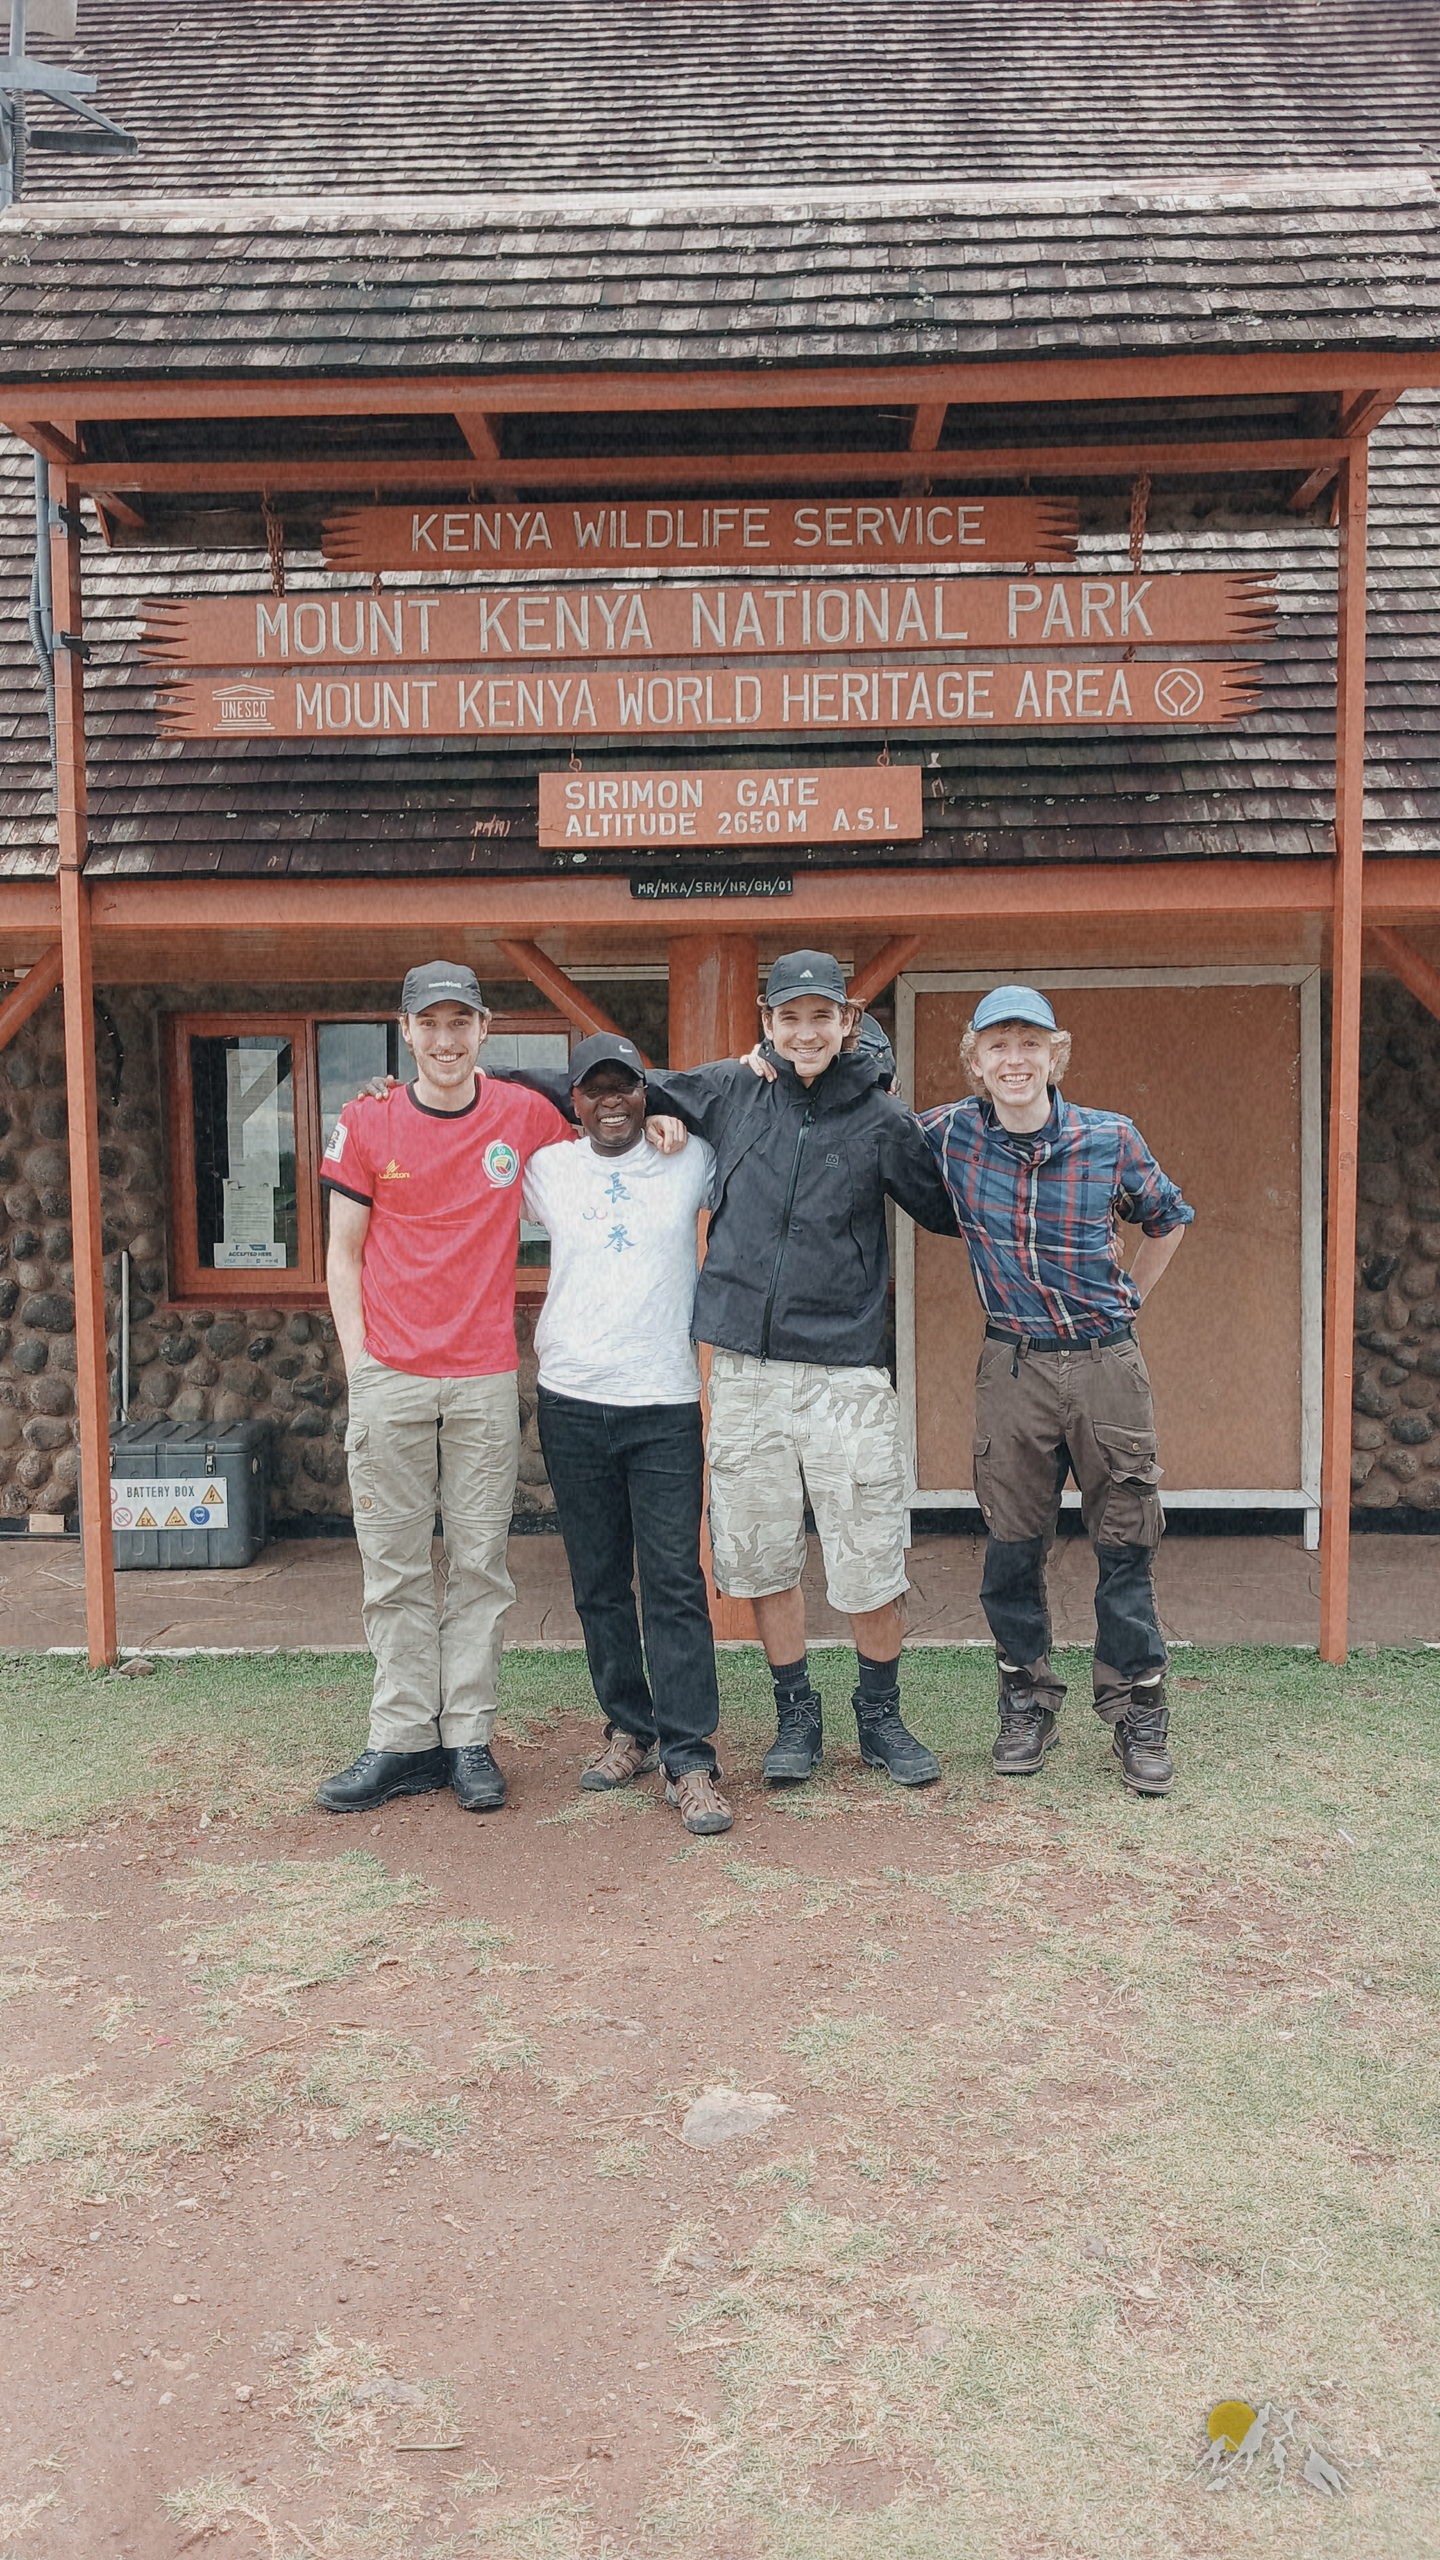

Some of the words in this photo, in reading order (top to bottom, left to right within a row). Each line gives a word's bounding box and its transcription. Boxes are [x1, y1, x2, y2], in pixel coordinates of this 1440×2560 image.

[411, 511, 552, 553] KENYA
[573, 508, 770, 549] WILDLIFE
[794, 506, 986, 547] SERVICE
[256, 599, 440, 658] MOUNT
[479, 594, 654, 653] KENYA
[692, 586, 968, 648] NATIONAL
[1007, 580, 1154, 640] PARK
[221, 700, 267, 719] UNESCO
[296, 680, 438, 731] MOUNT
[458, 677, 598, 729] KENYA
[617, 675, 762, 726] WORLD
[782, 669, 994, 723] HERITAGE
[1014, 668, 1133, 718] AREA
[564, 778, 703, 811] SIRIMON
[736, 776, 819, 808] GATE
[564, 811, 697, 839] ALTITUDE
[832, 806, 898, 833] A.S.L
[126, 1486, 170, 1498] BATTERY
[174, 1485, 195, 1497] BOX
